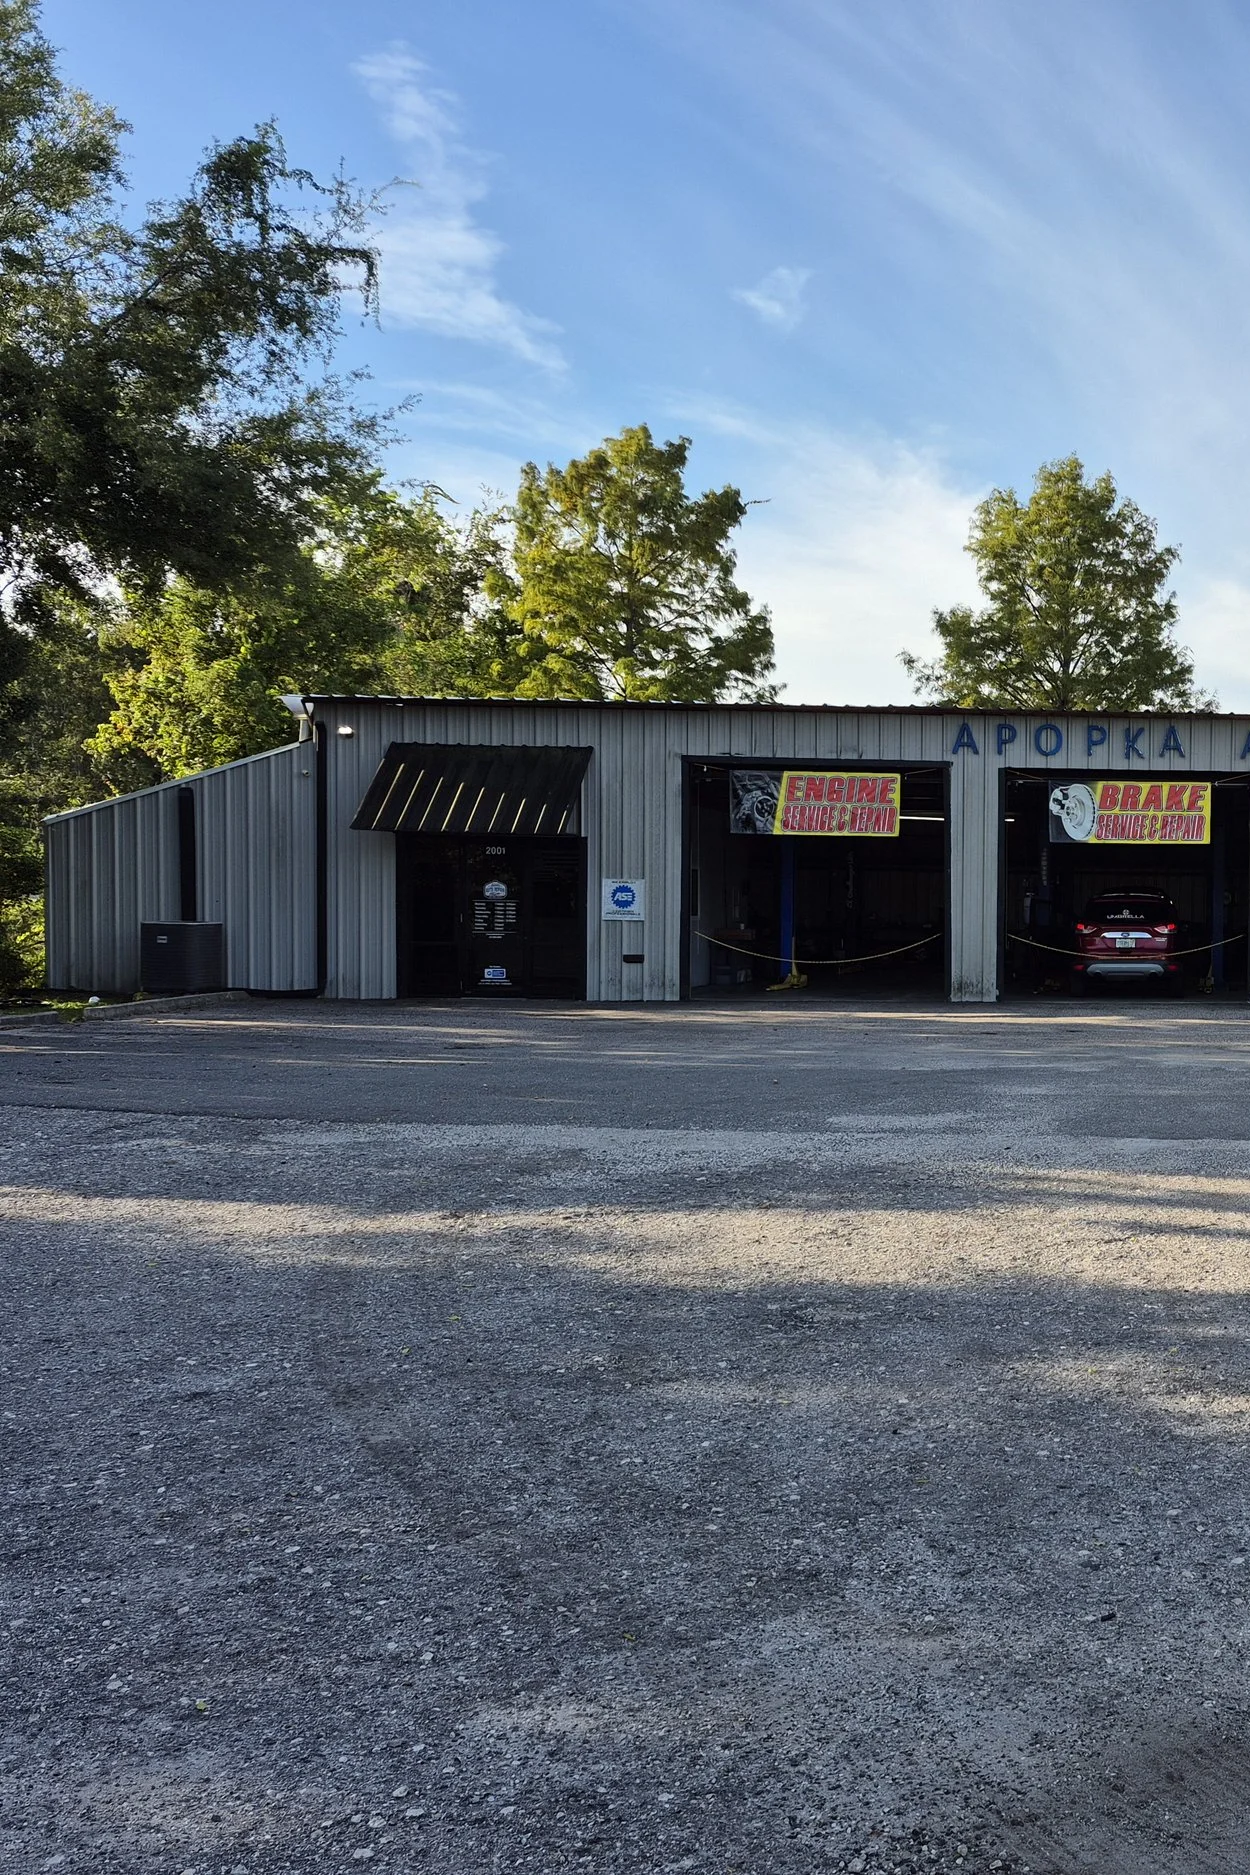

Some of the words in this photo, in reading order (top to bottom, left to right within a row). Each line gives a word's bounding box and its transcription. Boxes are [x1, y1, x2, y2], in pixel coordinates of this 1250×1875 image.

[952, 723, 1185, 758] APOPKA
[785, 776, 897, 803] ENGINE
[1099, 784, 1207, 811] BRAKE
[782, 804, 837, 832] SERVICE
[837, 806, 848, 833] &
[848, 806, 898, 834] REPAIR
[1096, 814, 1147, 840] SERVICE
[1148, 814, 1159, 841] &
[1159, 815, 1205, 841] REPAIR
[485, 846, 506, 855] 2001
[613, 892, 633, 901] ASE
